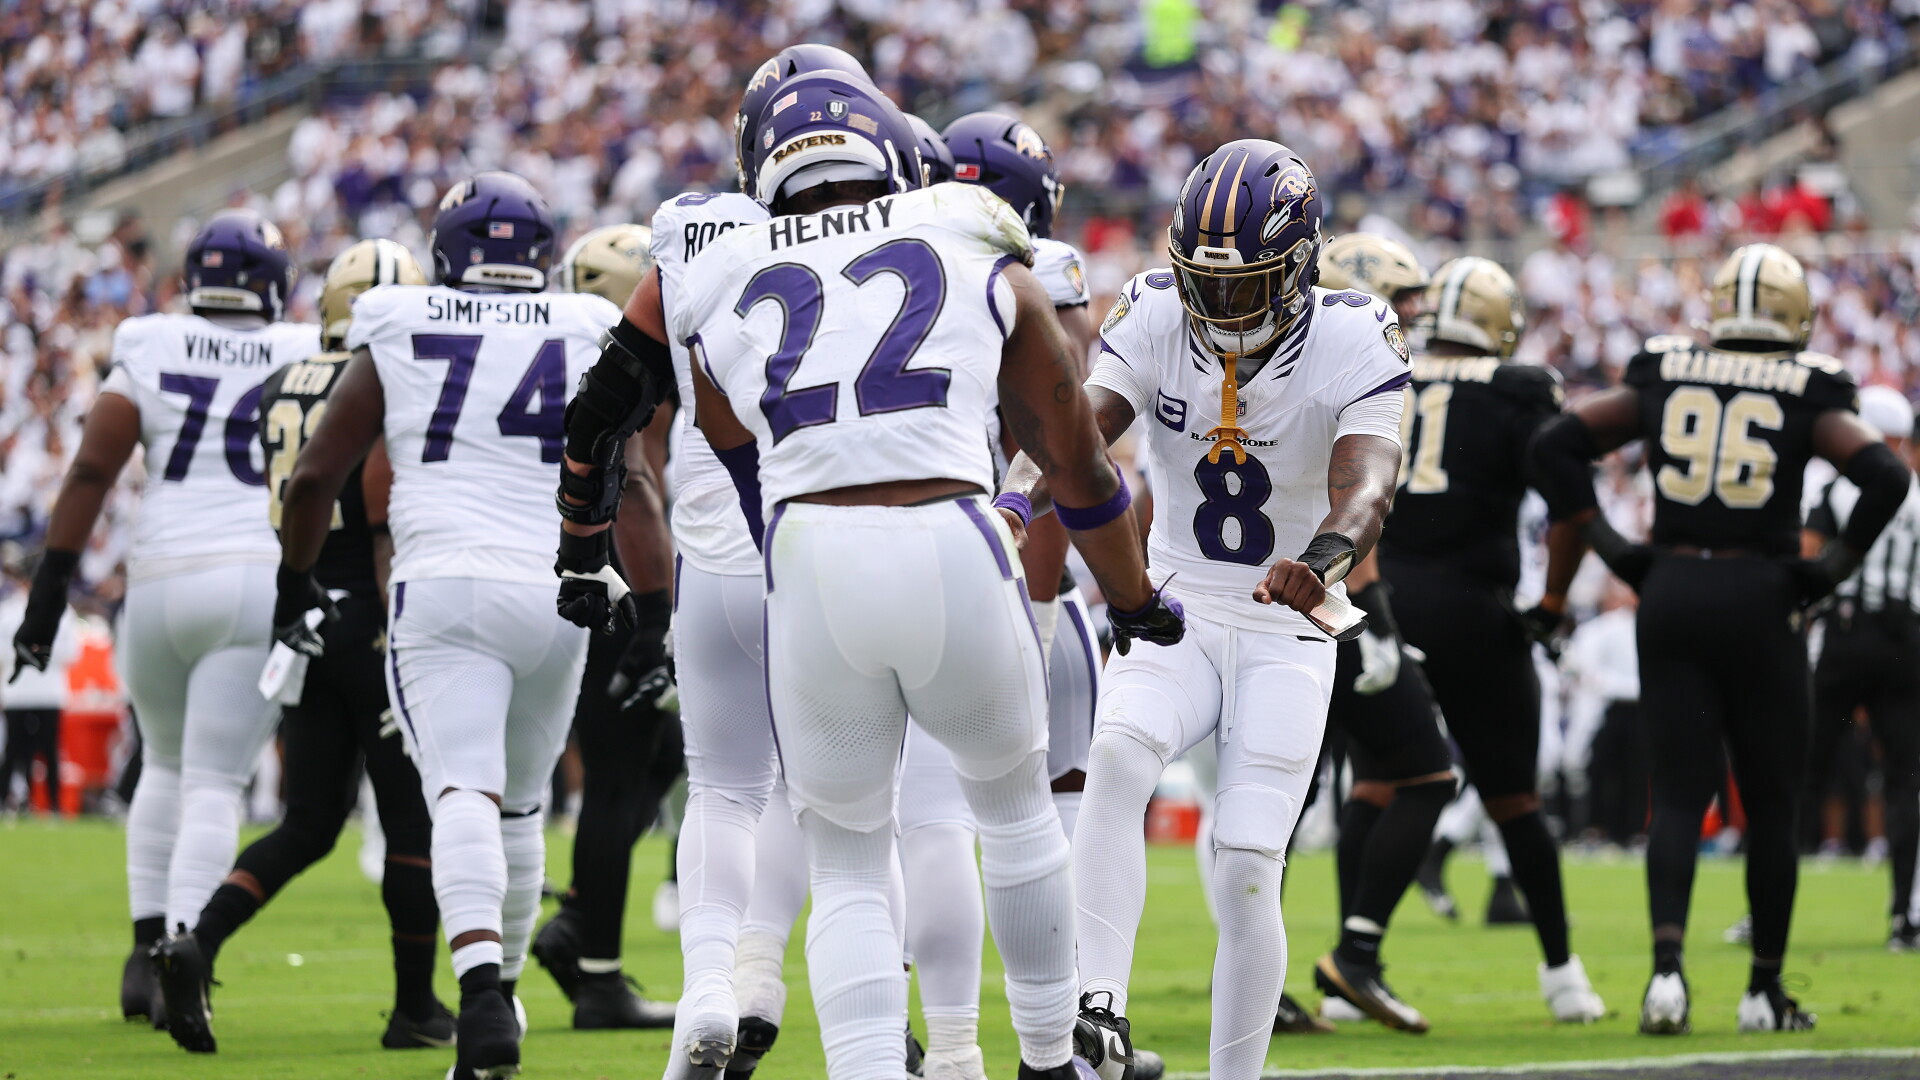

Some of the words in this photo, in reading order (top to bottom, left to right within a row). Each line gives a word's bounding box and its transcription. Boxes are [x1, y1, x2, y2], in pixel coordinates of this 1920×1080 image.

[809, 111, 822, 122] 22
[772, 134, 846, 165] RAVENS
[770, 199, 894, 251] HENRY
[1204, 251, 1230, 260] RAVENS
[427, 296, 550, 325] SIMPSON
[184, 334, 273, 366] VINSON
[734, 238, 952, 448] 22
[411, 334, 567, 464] 74
[1656, 385, 1785, 509] 96
[1193, 450, 1276, 567] 8
